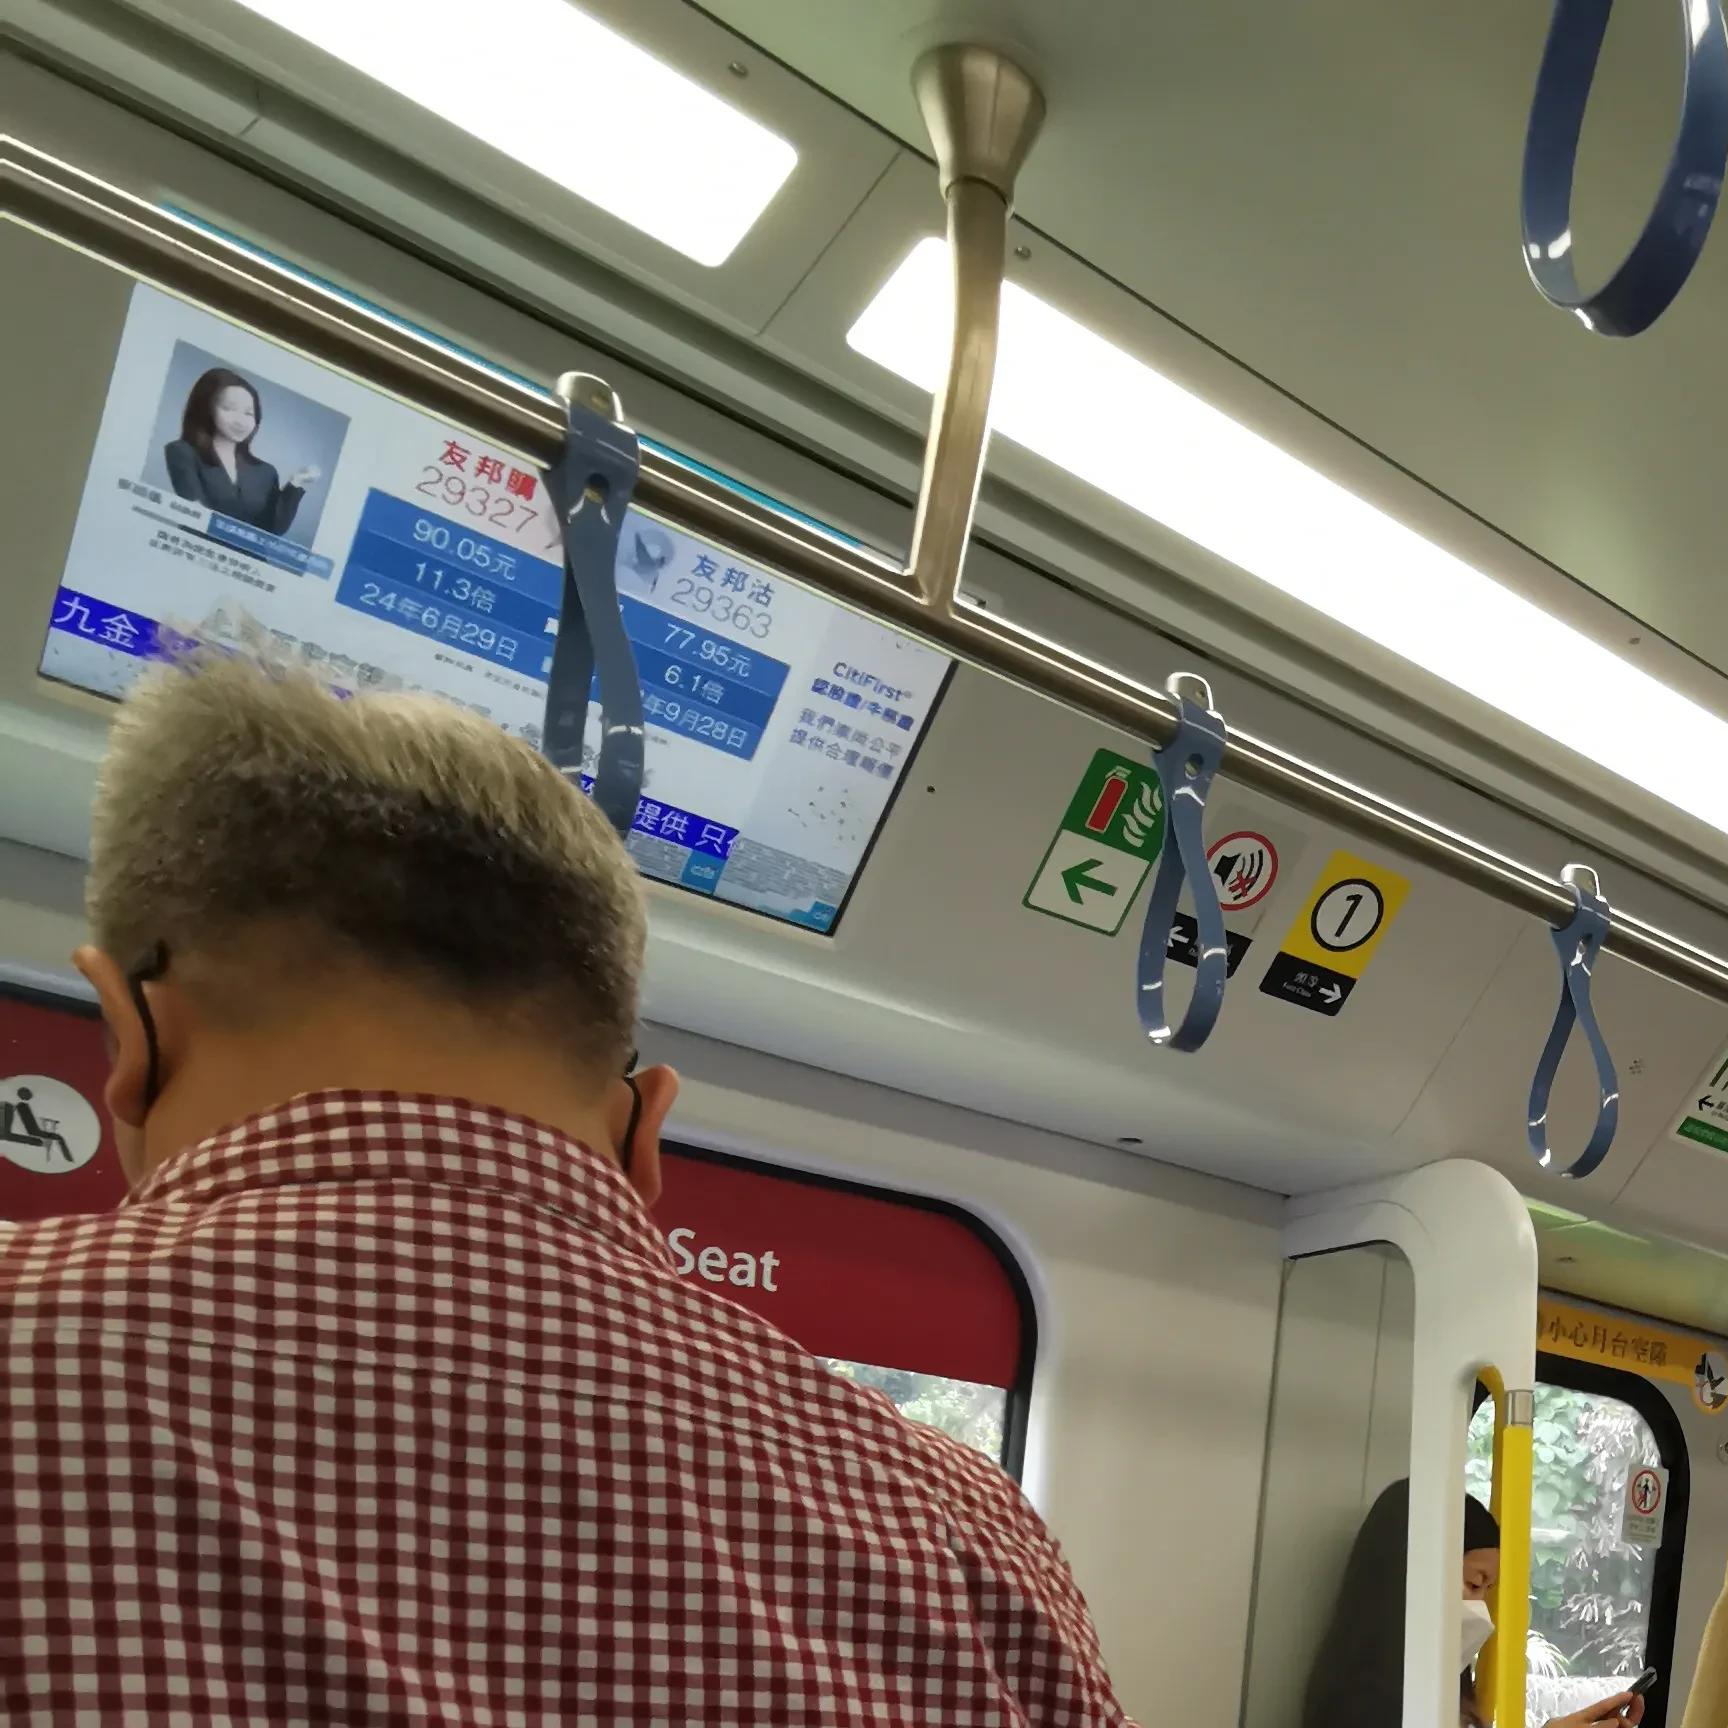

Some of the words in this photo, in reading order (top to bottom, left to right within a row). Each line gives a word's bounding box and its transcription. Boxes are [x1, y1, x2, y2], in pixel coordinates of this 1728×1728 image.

[415, 465, 539, 533] 29327
[412, 518, 517, 582] 90.05元
[415, 561, 497, 614] 11.3倍
[670, 577, 773, 639] 29363
[691, 553, 776, 608] 友邦沽
[359, 582, 520, 662] 24年6月29日
[664, 623, 752, 678] 77.95元
[664, 665, 725, 704] 6.1倍
[640, 689, 748, 750] 年9月28日
[1334, 893, 1363, 938] 1
[667, 1227, 780, 1292] Seat
[1537, 1316, 1668, 1368] 小心月台空隙
